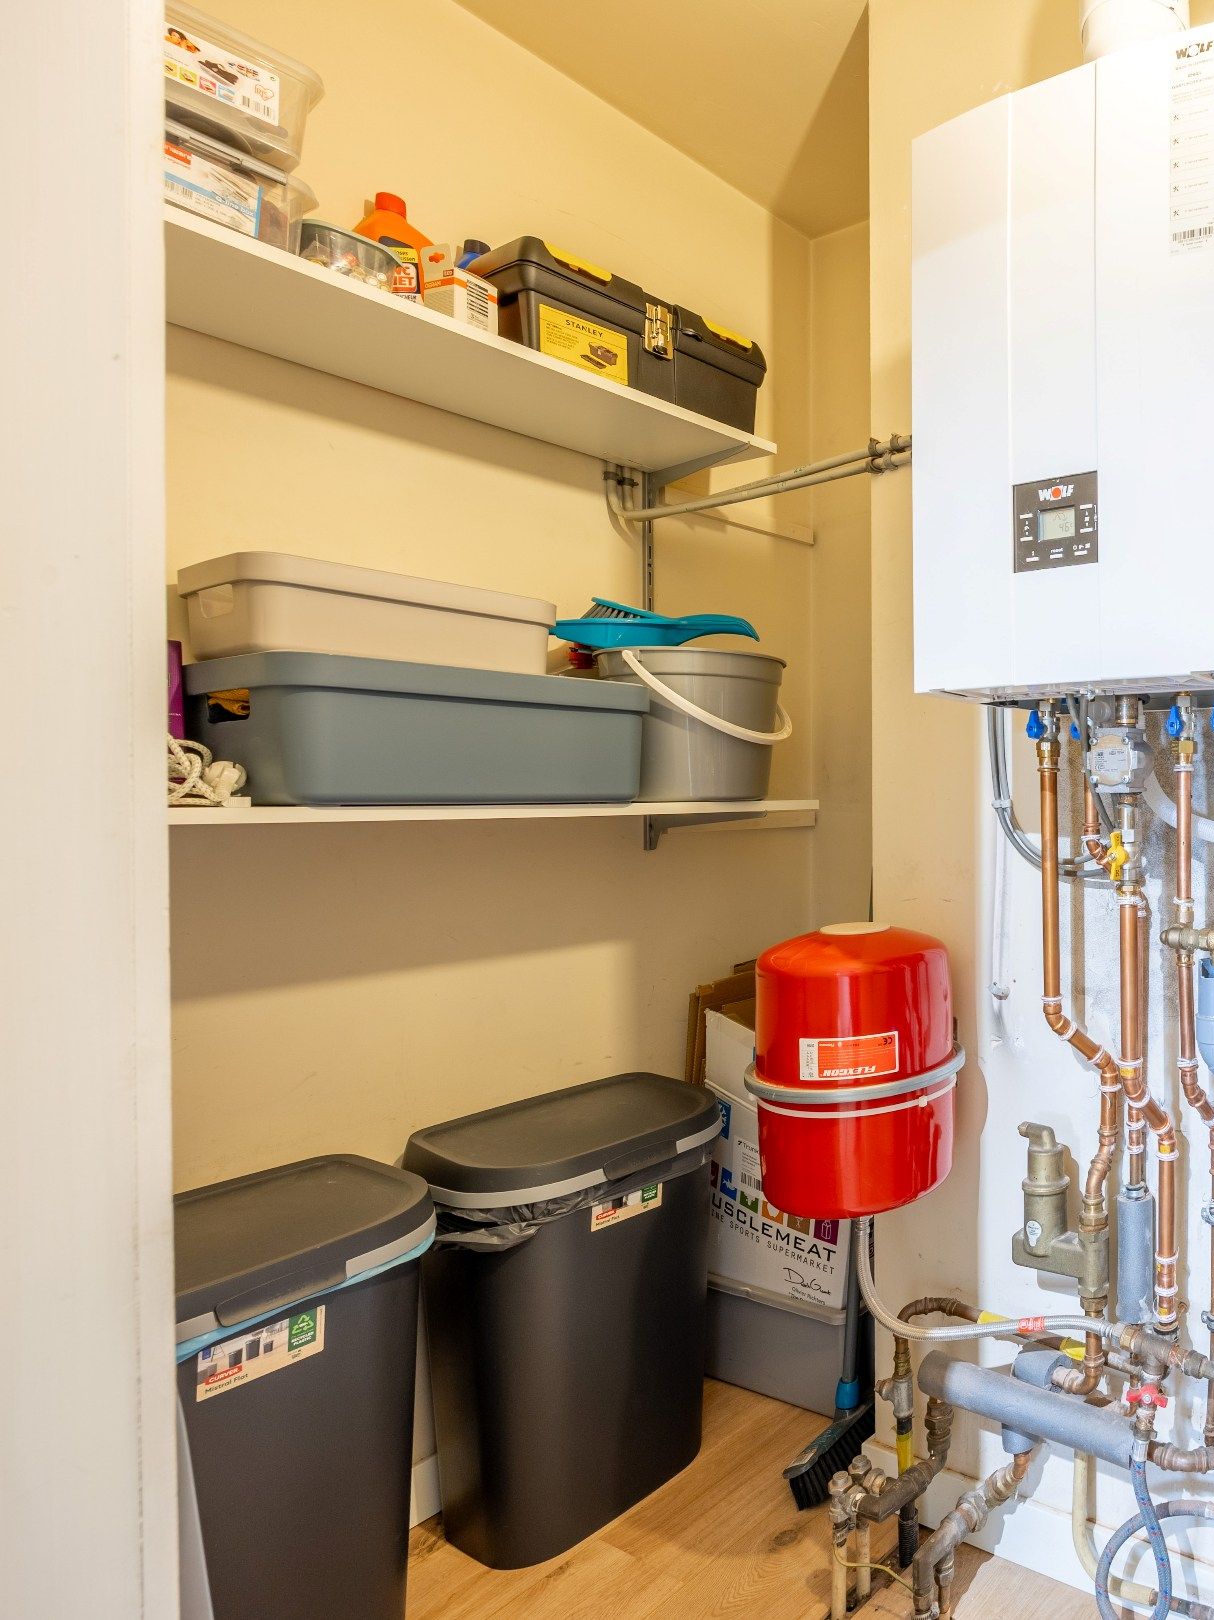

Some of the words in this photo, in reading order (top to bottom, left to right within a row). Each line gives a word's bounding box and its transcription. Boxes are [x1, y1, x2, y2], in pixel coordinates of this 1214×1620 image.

[1176, 40, 1213, 59] WOLF
[565, 319, 603, 338] STANLEY
[1038, 484, 1074, 501] WOLF
[822, 1065, 877, 1077] FLEXCON
[711, 1192, 837, 1262] USCLEMEAT
[729, 1220, 761, 1244] SPORTS
[766, 1240, 835, 1275] SUPERMARKET
[204, 1380, 232, 1395] Mistral
[233, 1373, 249, 1383] Flat
[208, 1368, 240, 1383] CURVER
